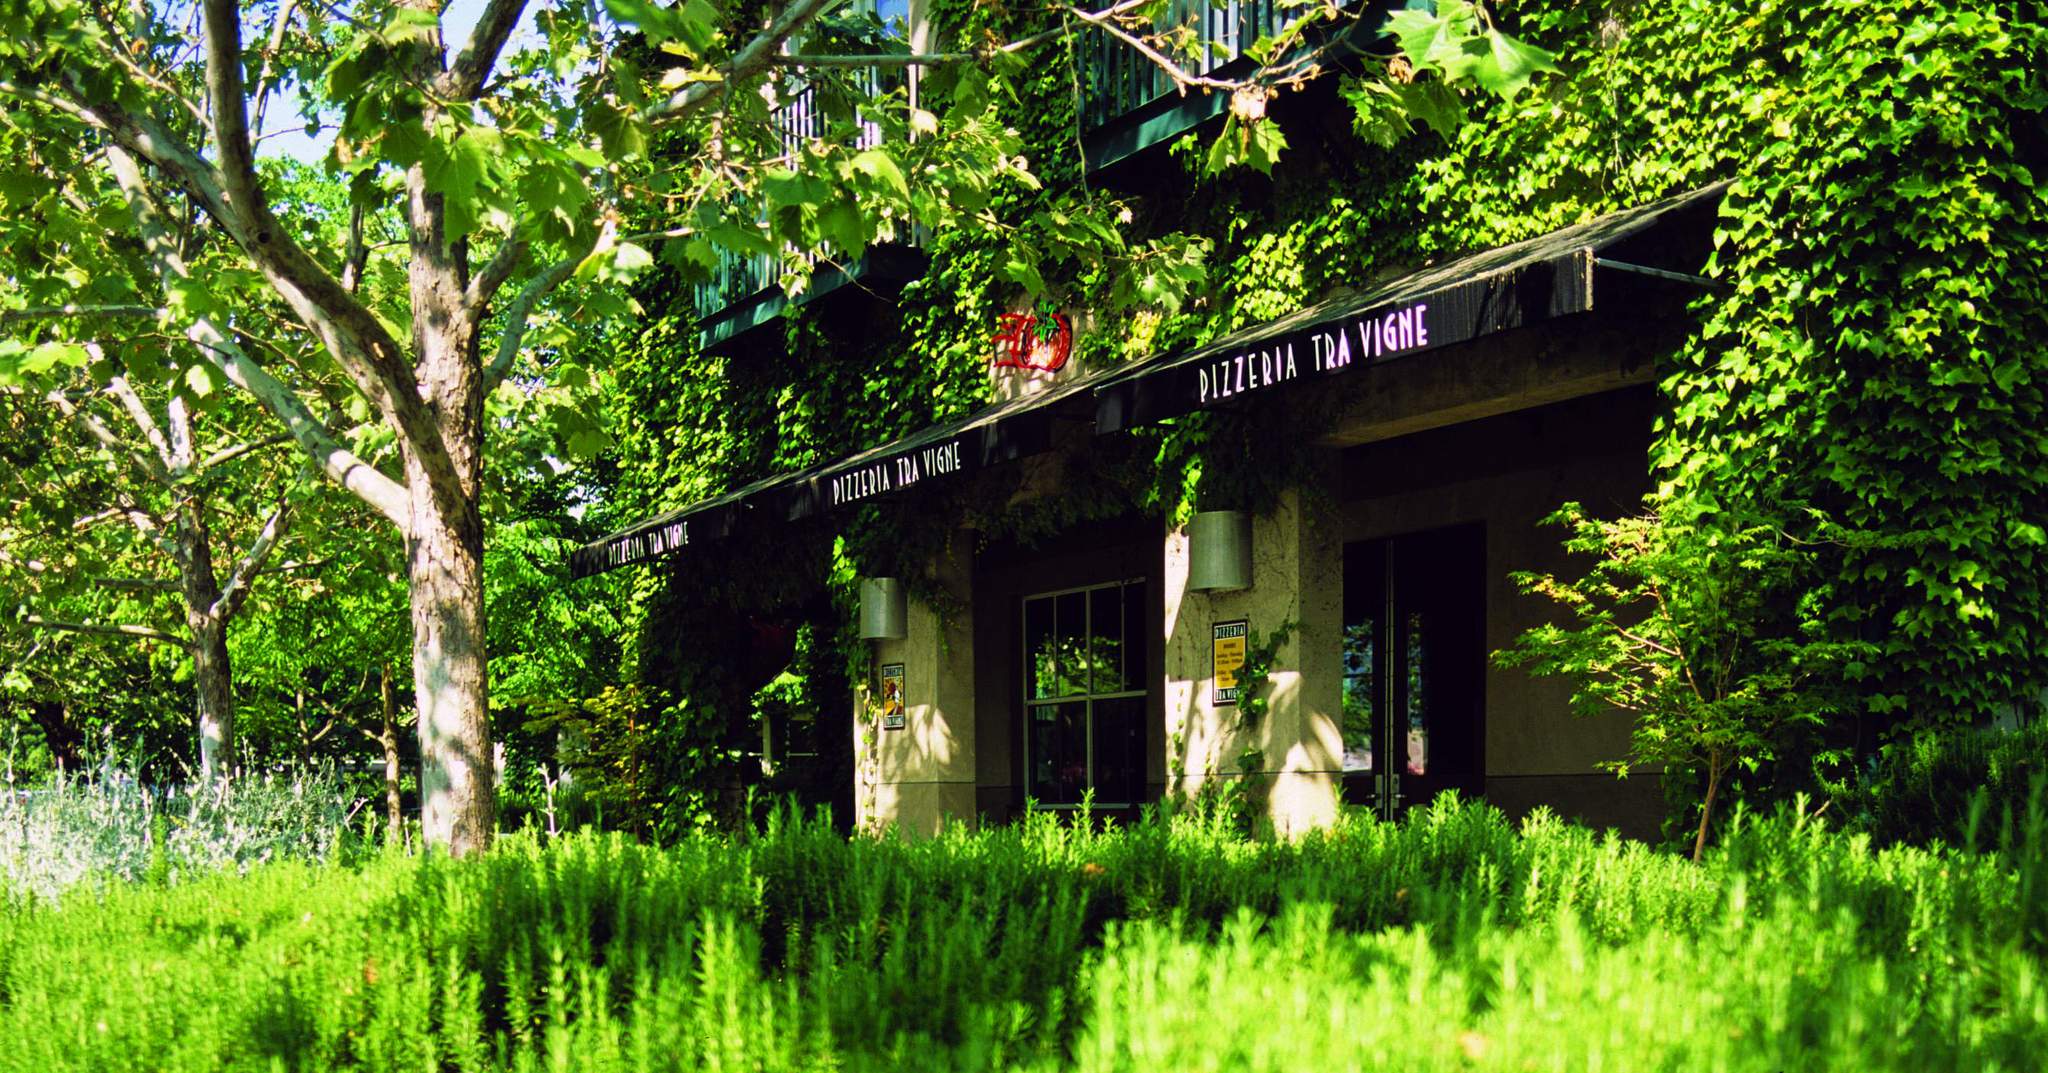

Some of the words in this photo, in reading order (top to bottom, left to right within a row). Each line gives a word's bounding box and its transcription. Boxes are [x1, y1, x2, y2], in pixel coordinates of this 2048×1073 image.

[1199, 342, 1298, 403] PIZZERIA
[1311, 327, 1351, 372] TRA
[1359, 304, 1428, 359] VIGNE
[832, 463, 891, 506] PIZZERIA
[896, 454, 920, 487] TRA
[922, 441, 961, 478] VIGNE
[608, 535, 646, 568] PIZZERIA
[647, 530, 664, 556] TRA
[663, 520, 689, 550] VIGNE
